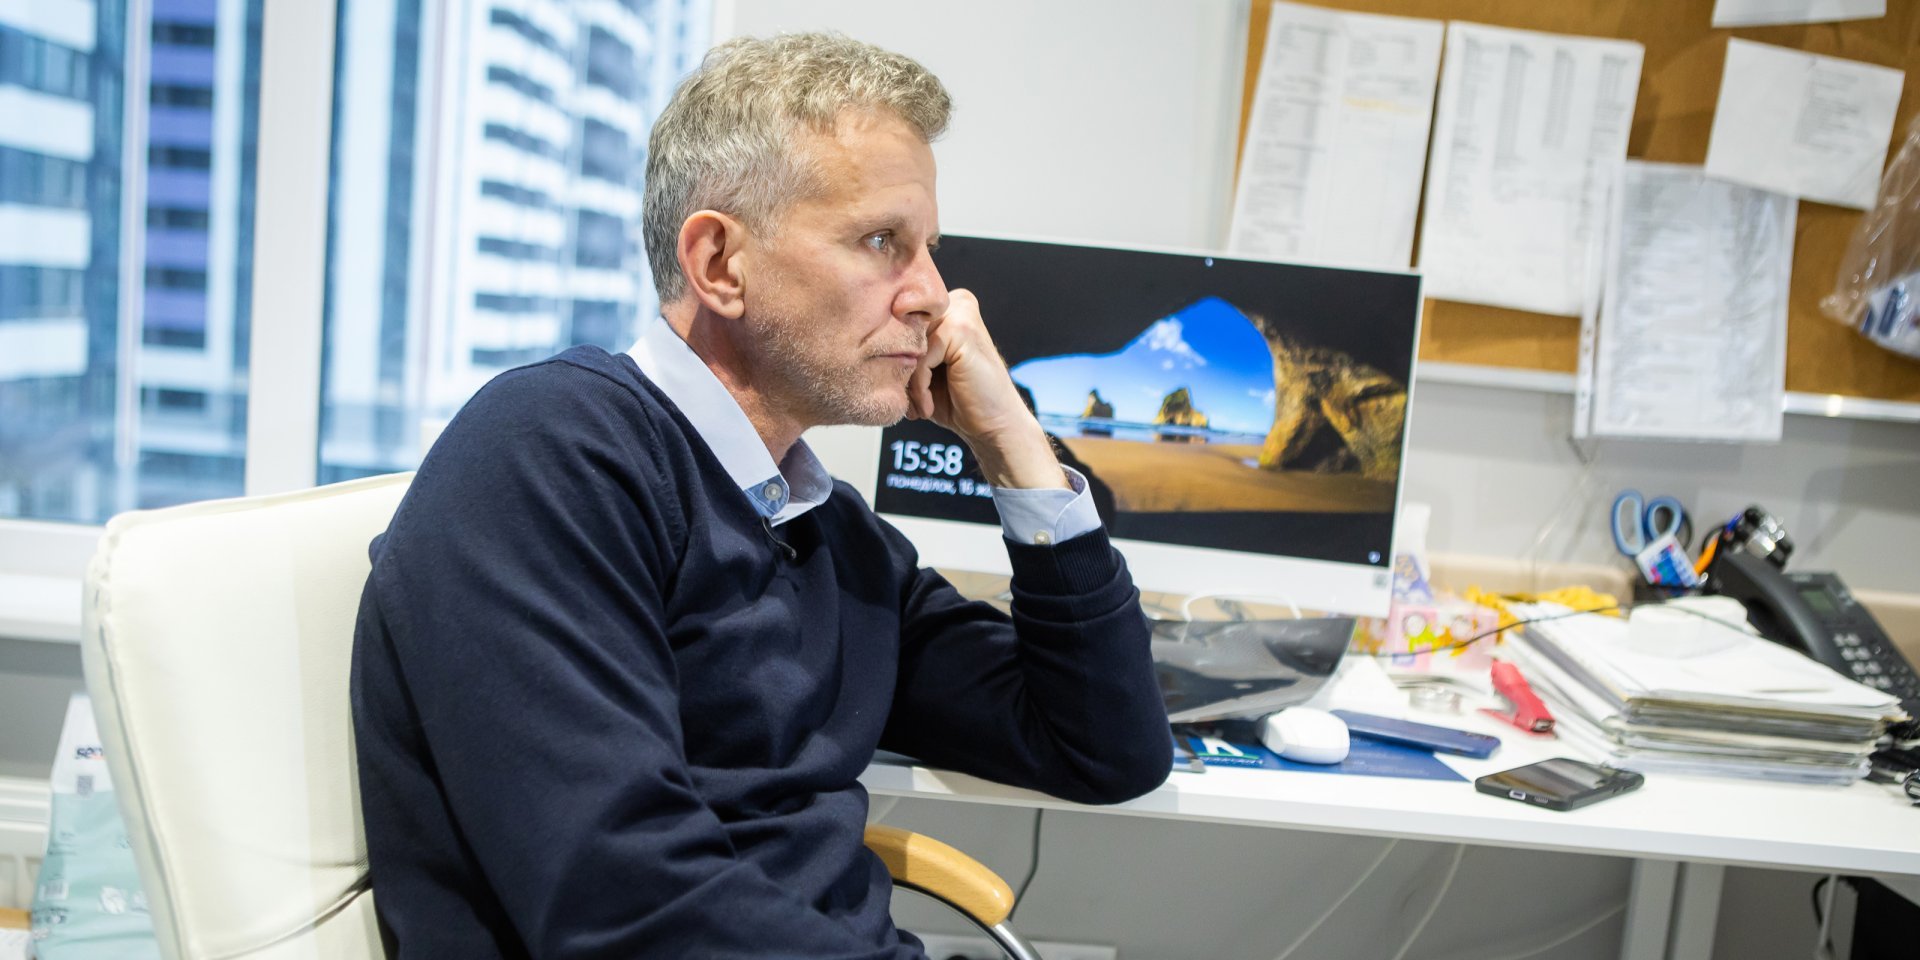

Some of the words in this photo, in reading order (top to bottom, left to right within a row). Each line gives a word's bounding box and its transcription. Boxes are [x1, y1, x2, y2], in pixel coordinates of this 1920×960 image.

[891, 440, 963, 475] 15:58
[886, 474, 956, 495] понеділок,
[960, 479, 974, 495] 16
